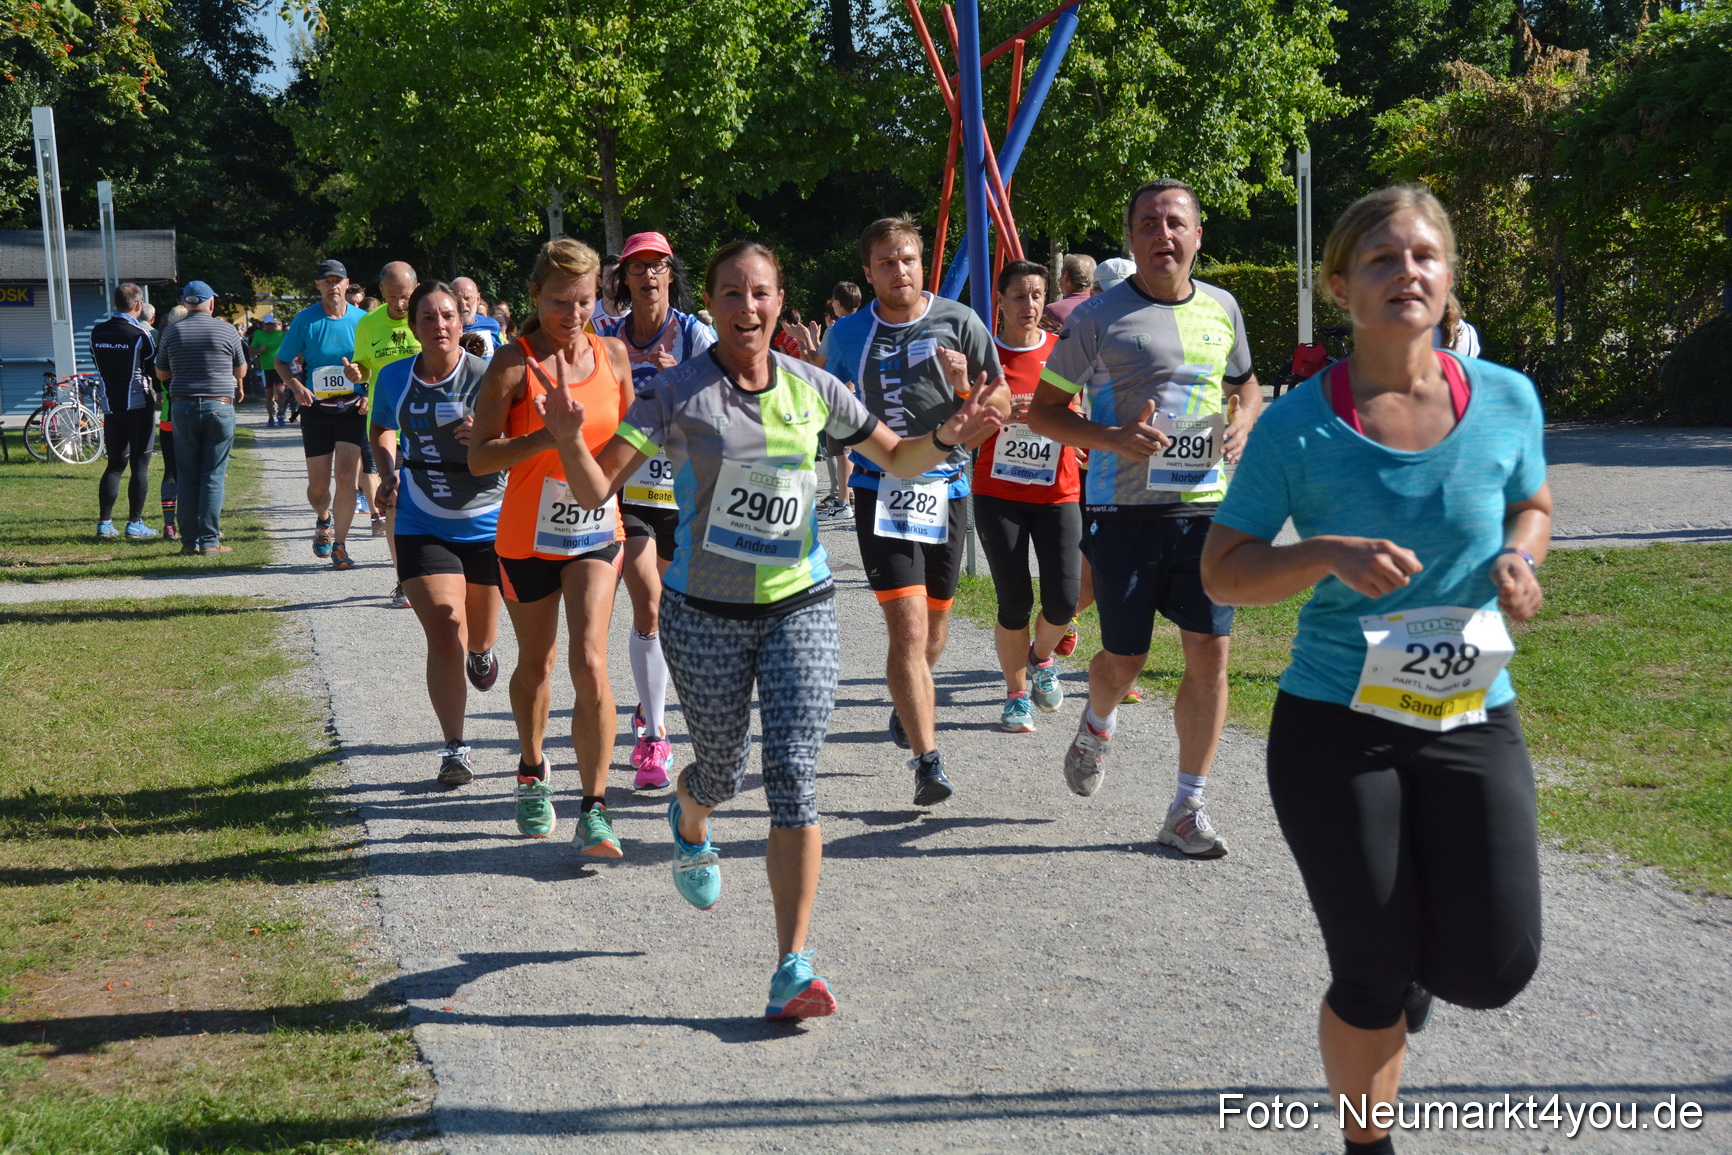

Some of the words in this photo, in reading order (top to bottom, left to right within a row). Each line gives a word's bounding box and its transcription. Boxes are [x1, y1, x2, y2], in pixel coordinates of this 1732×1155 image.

[323, 375, 344, 387] 180
[1004, 440, 1051, 461] 2304
[1163, 435, 1213, 459] 2891
[649, 459, 673, 480] 93
[1171, 473, 1204, 483] Norbert
[749, 472, 792, 490] BOCK
[648, 490, 673, 502] Beate
[889, 490, 938, 516] 2282
[726, 487, 799, 525] 2900
[554, 526, 572, 534] PARTL
[730, 520, 752, 531] PARTL
[753, 526, 783, 536] Neumarkt
[897, 522, 928, 536] Markus
[563, 536, 590, 549] Ingrid
[735, 536, 778, 555] Andrea
[1406, 617, 1466, 635] BOCK
[1400, 641, 1480, 680] 238
[1392, 677, 1423, 689] PARTL
[1426, 682, 1461, 693] Neumarkt
